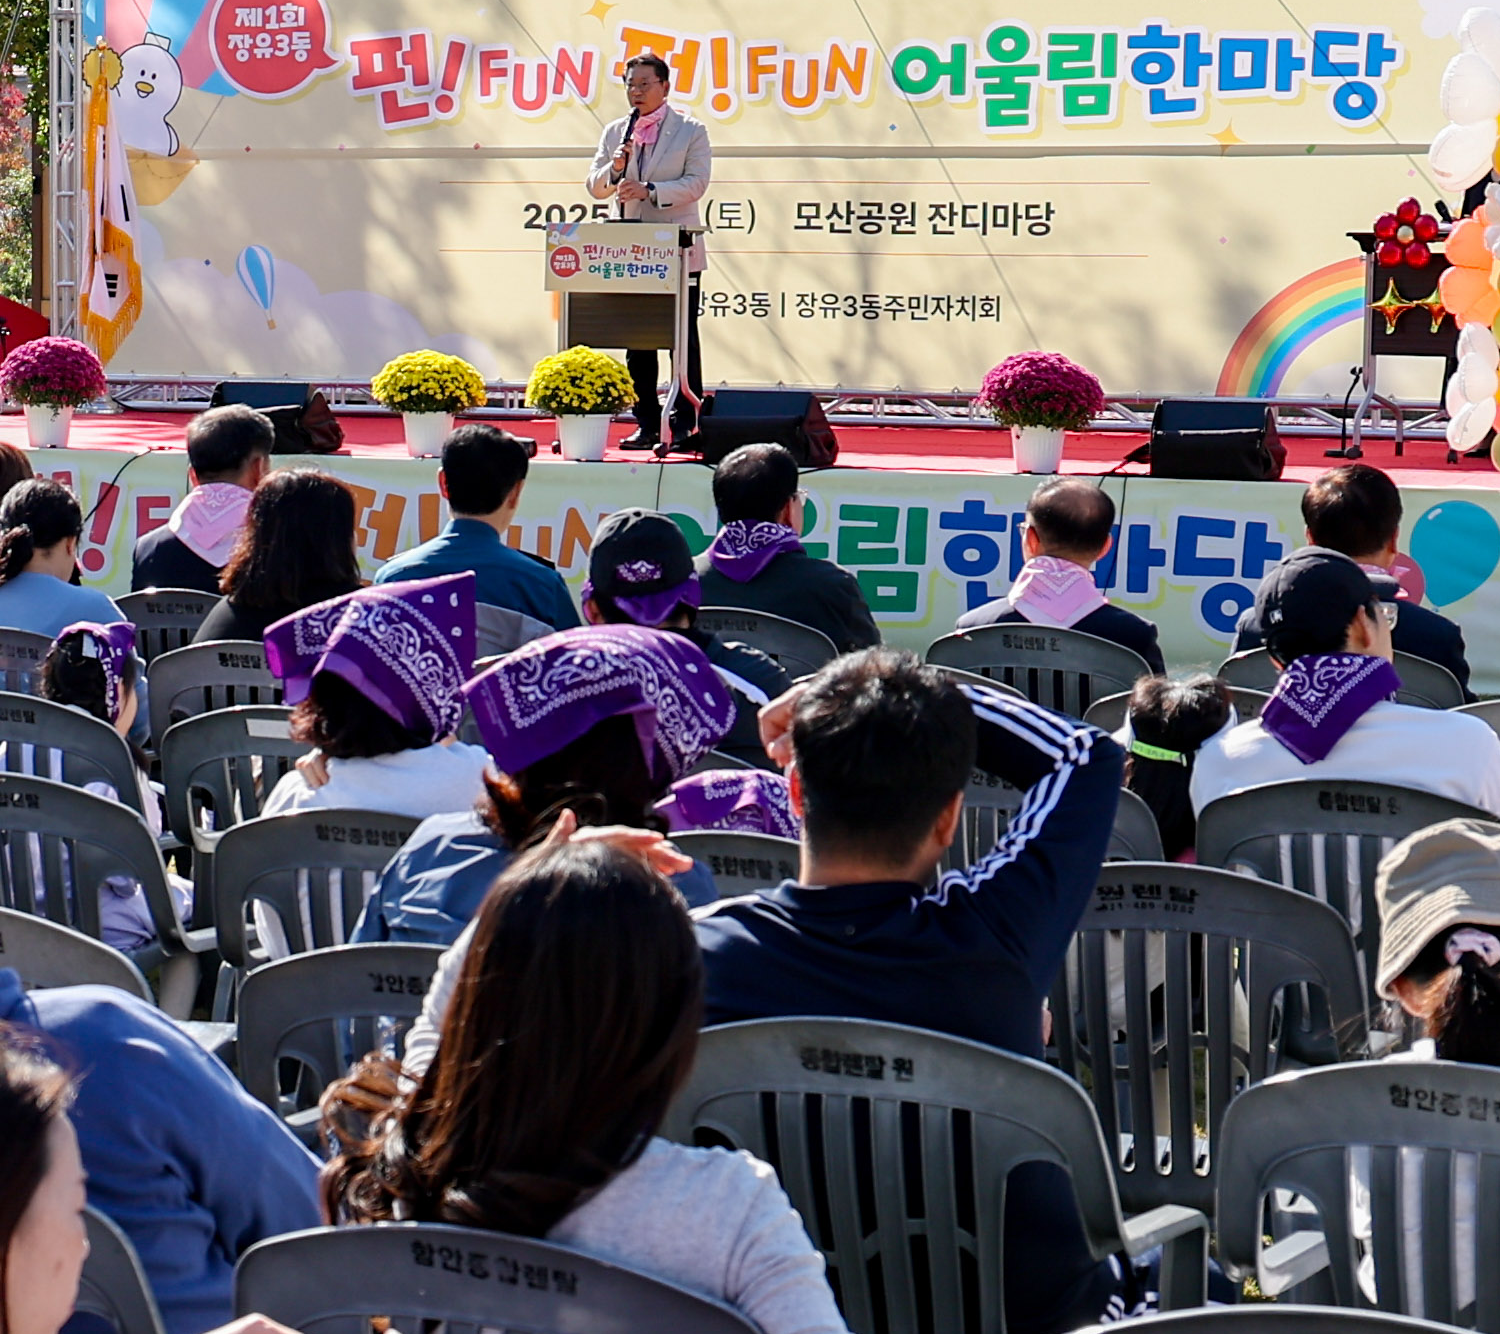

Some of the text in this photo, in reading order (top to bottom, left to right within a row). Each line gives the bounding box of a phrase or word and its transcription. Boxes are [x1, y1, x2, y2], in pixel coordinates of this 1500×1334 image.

[234, 2, 306, 29] 제1회
[227, 31, 313, 63] 장유3동
[793, 201, 918, 236] 모산공원
[927, 200, 1056, 236] 잔디마당
[587, 262, 669, 280] 어울림한마당
[794, 291, 1002, 323] 장유3동주민자치회
[891, 1056, 915, 1083] 원
